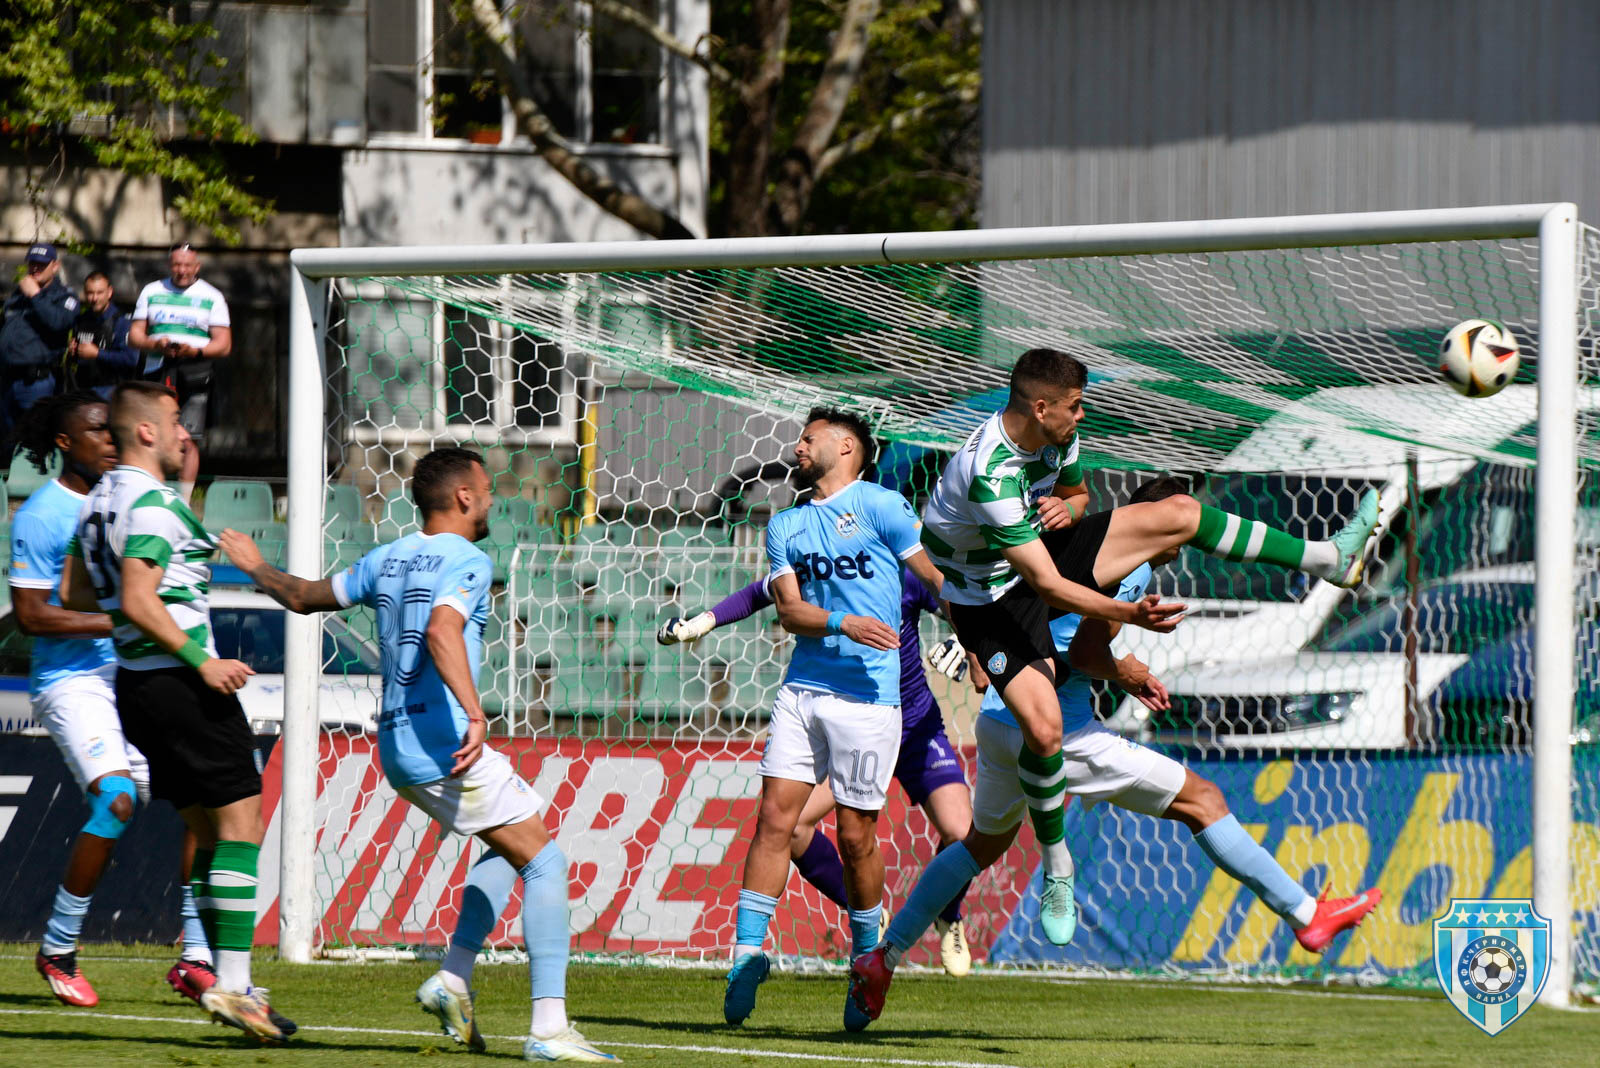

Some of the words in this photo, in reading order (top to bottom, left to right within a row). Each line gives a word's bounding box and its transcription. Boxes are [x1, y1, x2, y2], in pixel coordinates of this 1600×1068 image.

[929, 739, 945, 758] 1
[849, 748, 879, 785] 10
[844, 785, 873, 796] uhlsport
